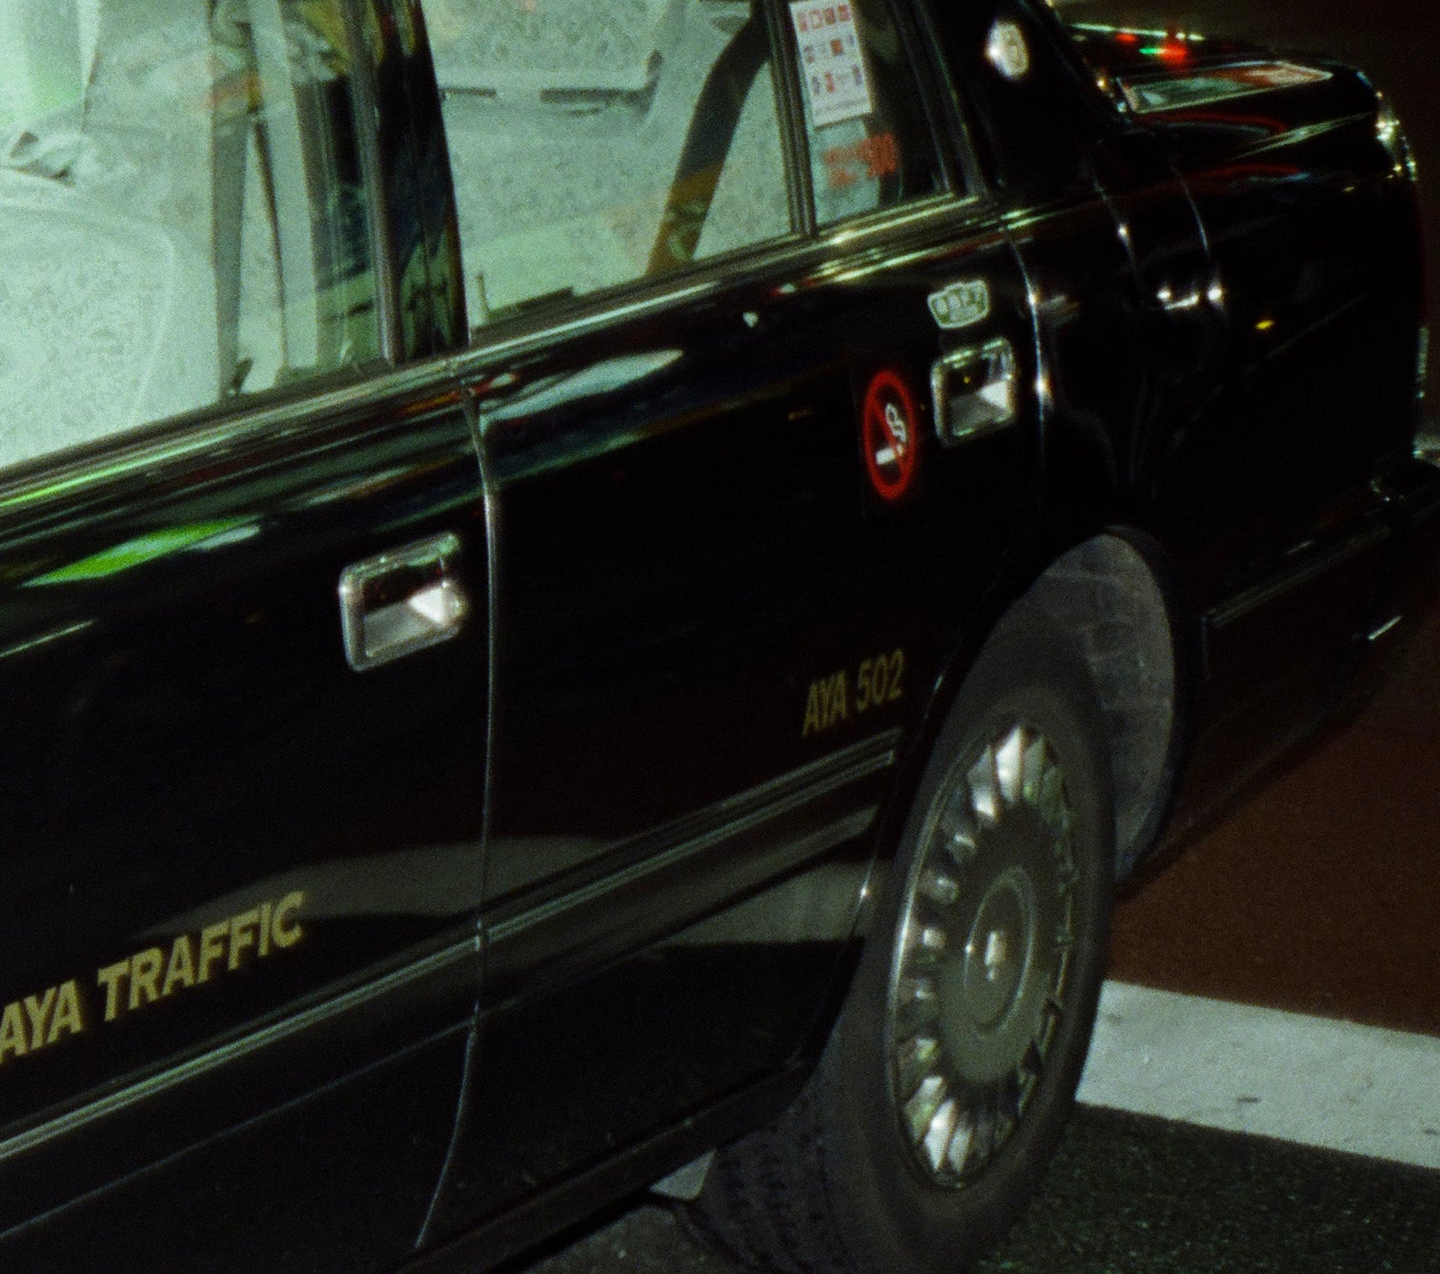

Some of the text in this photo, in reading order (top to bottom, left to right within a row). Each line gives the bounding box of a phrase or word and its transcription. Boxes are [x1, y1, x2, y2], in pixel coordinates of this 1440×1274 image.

[803, 648, 905, 736] AYA 502
[97, 891, 306, 1022] TRAFFIC
